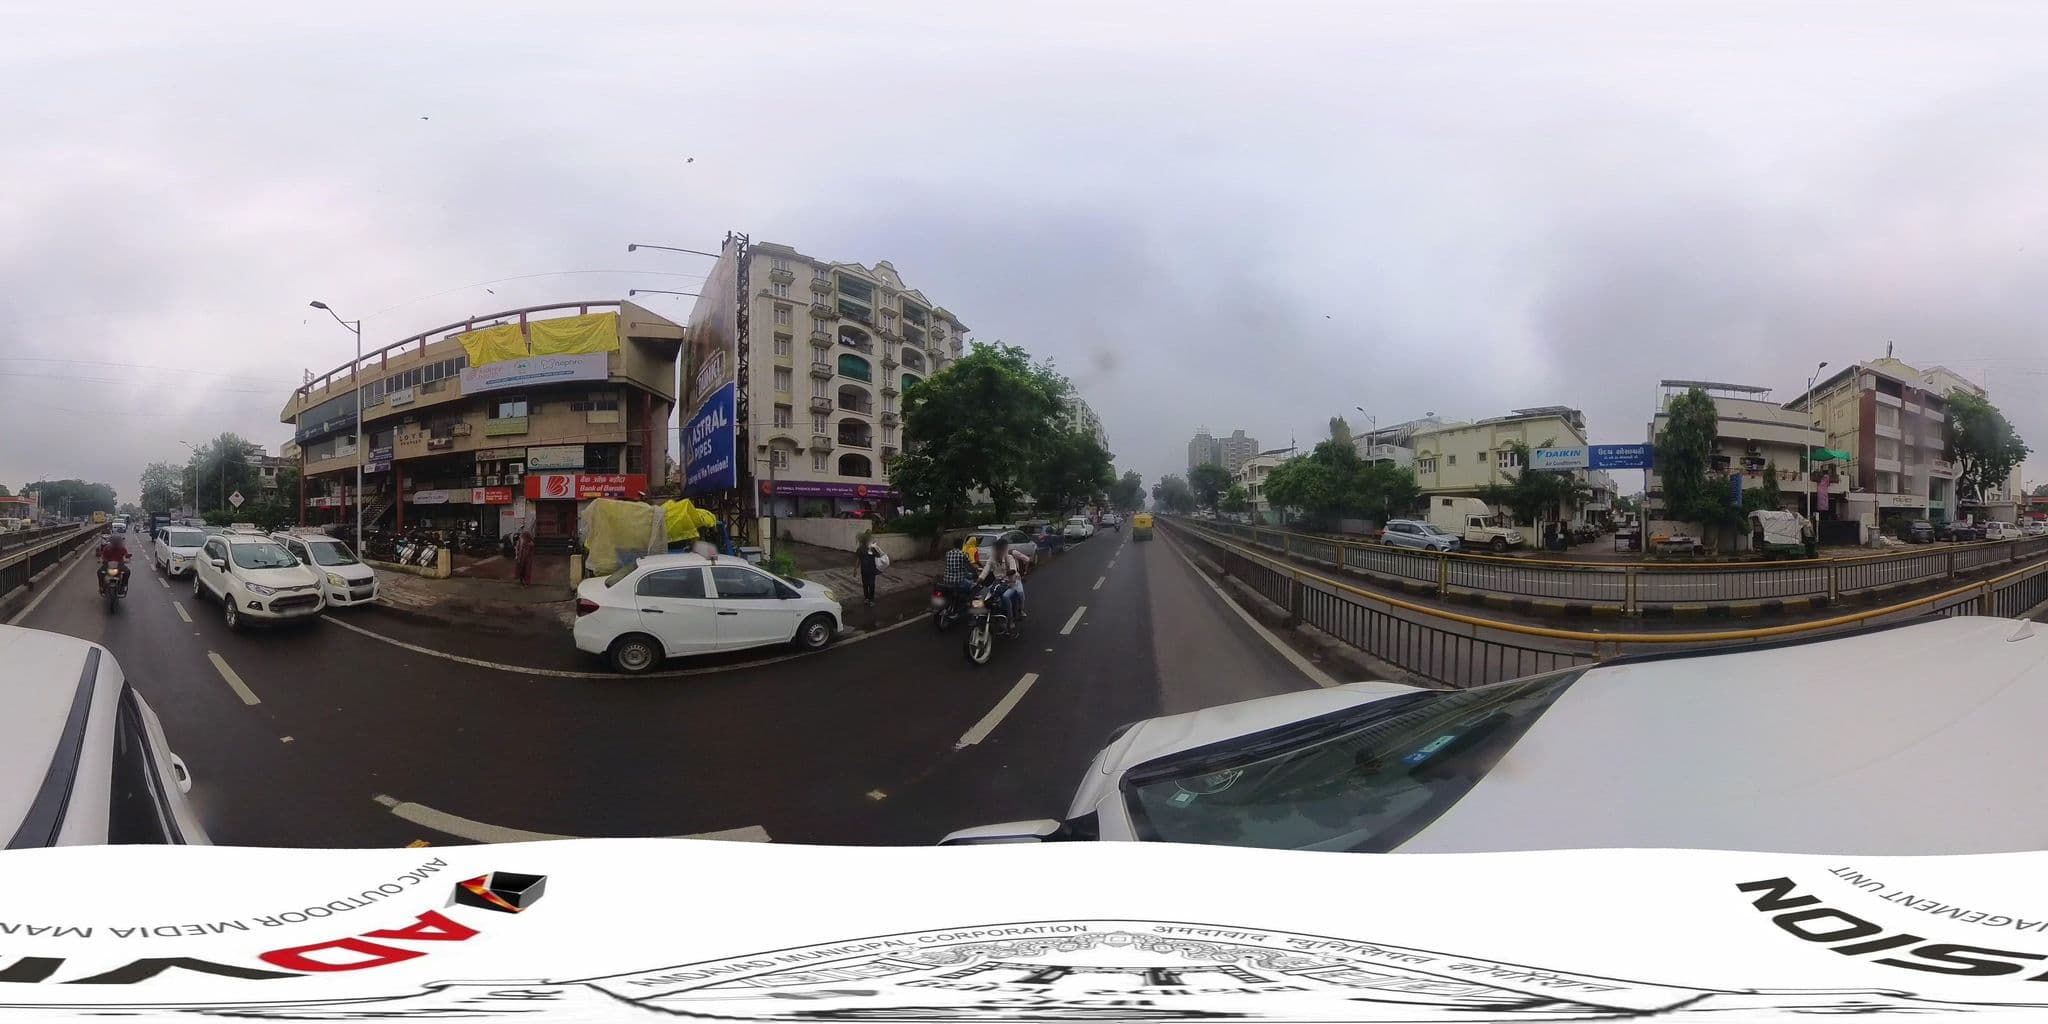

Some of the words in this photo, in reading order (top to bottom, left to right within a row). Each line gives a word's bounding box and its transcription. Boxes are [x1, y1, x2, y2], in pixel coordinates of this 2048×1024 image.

[692, 406, 728, 446] ASTRAL
[695, 438, 712, 461] PIPES
[1545, 449, 1582, 458] DAIKIN
[579, 484, 597, 492] Bank
[596, 484, 604, 492] of
[603, 484, 626, 492] Baroda
